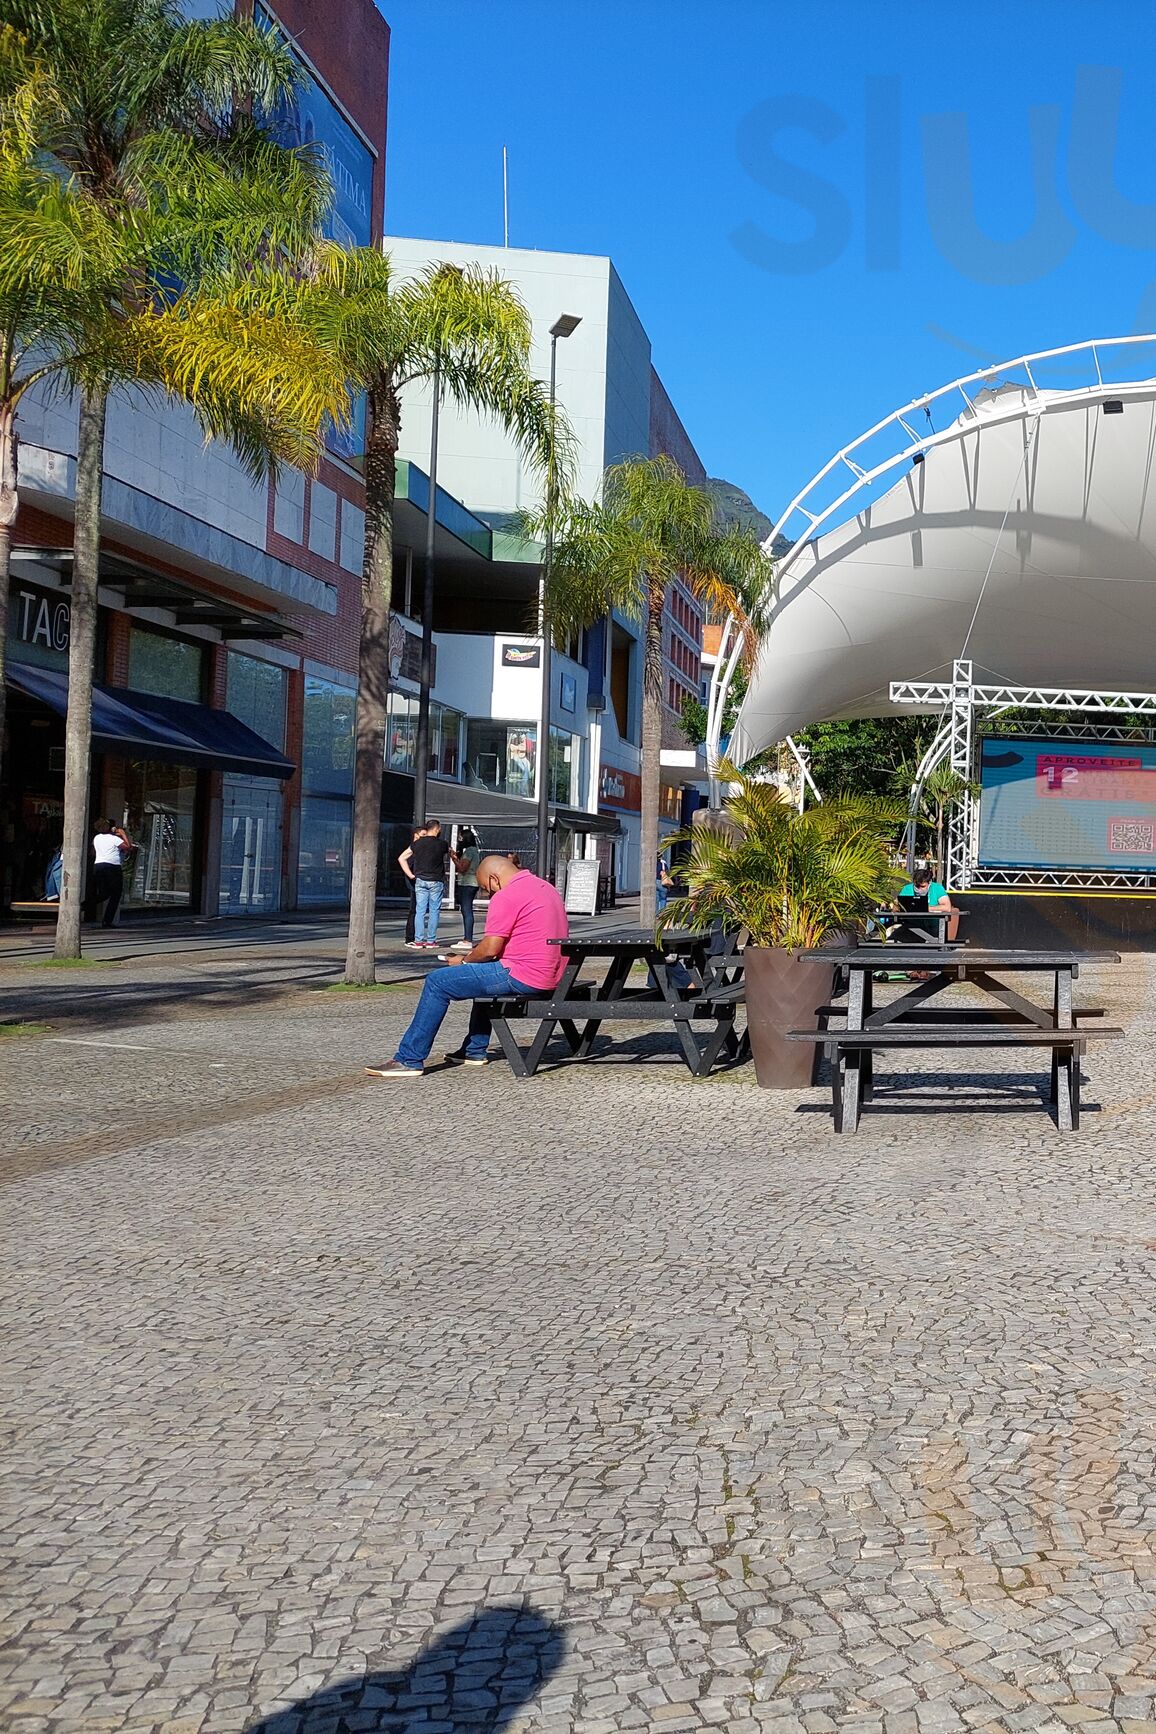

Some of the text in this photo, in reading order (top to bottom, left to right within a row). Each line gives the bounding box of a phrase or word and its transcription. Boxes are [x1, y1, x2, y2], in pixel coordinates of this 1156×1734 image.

[20, 590, 70, 651] TAC
[1042, 756, 1136, 767] APROVEITE
[1042, 767, 1079, 783] 12
